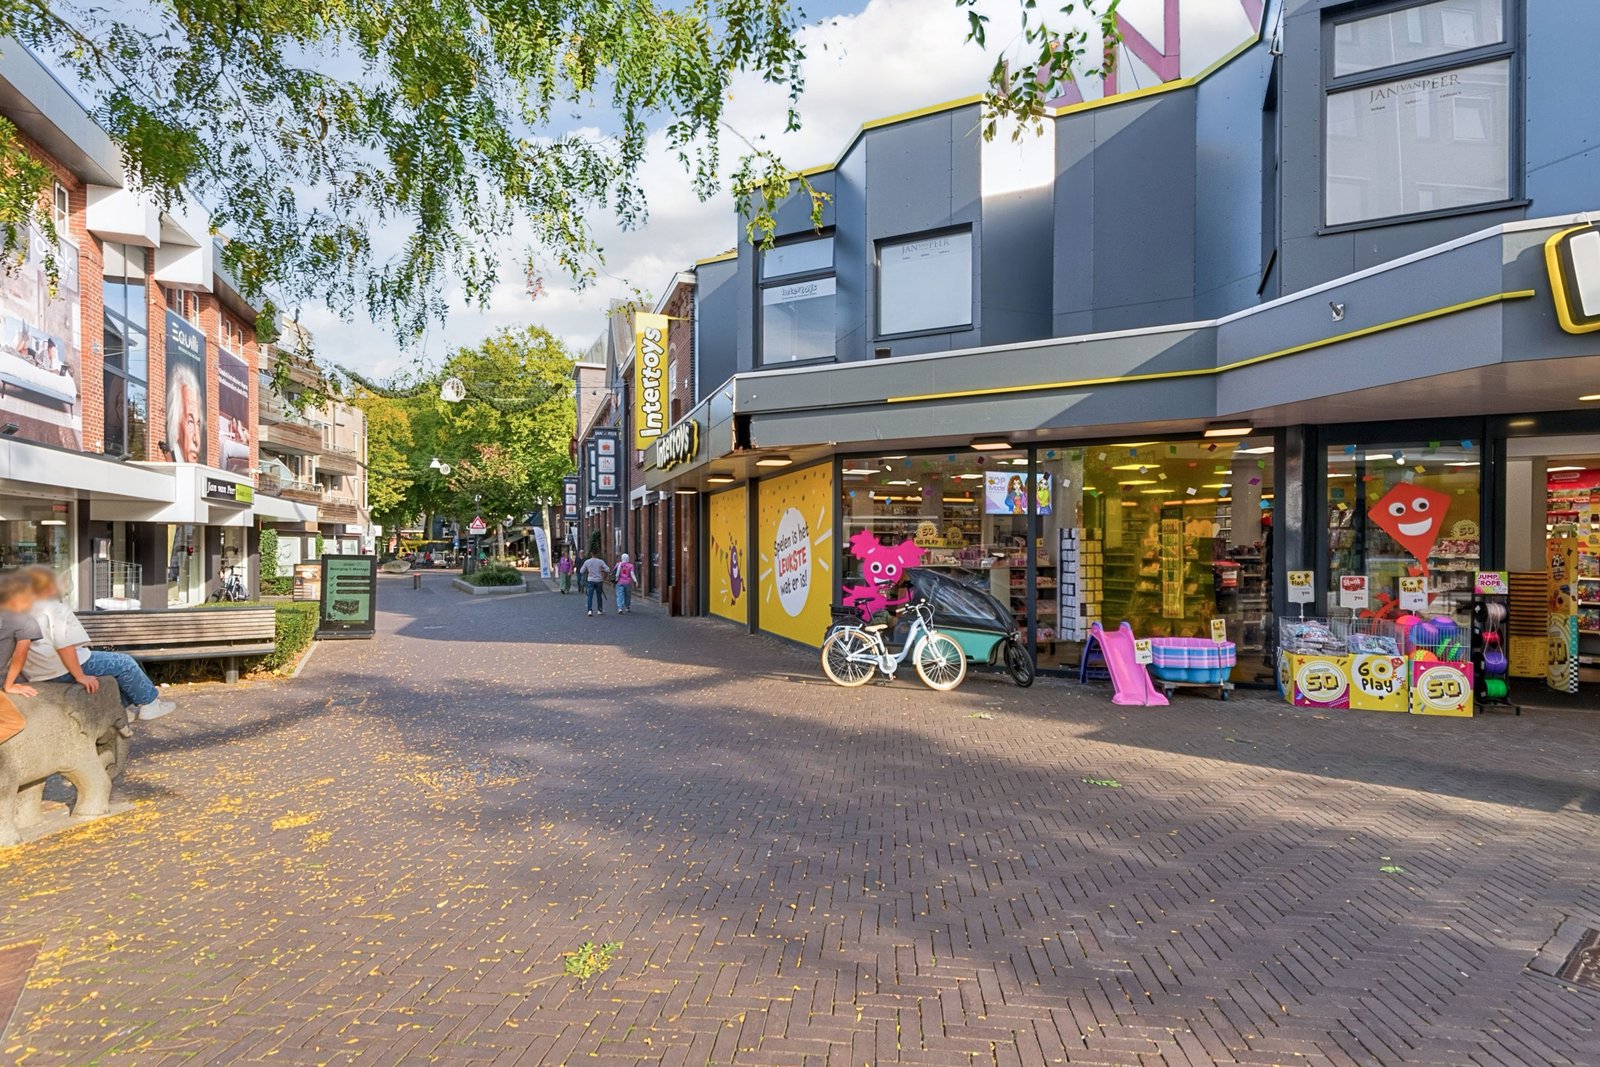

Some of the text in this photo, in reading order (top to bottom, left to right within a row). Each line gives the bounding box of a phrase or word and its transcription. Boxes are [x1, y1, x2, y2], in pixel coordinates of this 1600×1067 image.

[1369, 86, 1398, 104] JAN
[1422, 74, 1461, 91] PEER
[781, 284, 818, 296] Intertoys
[639, 327, 664, 438] Intertoys
[656, 423, 690, 469] Intertoys
[774, 522, 809, 560] Spelen is het
[1459, 526, 1475, 537] 50
[778, 546, 807, 578] LEUKSTE
[780, 569, 808, 596] wat er is!
[1306, 672, 1339, 692] 50
[1426, 679, 1462, 699] 50
